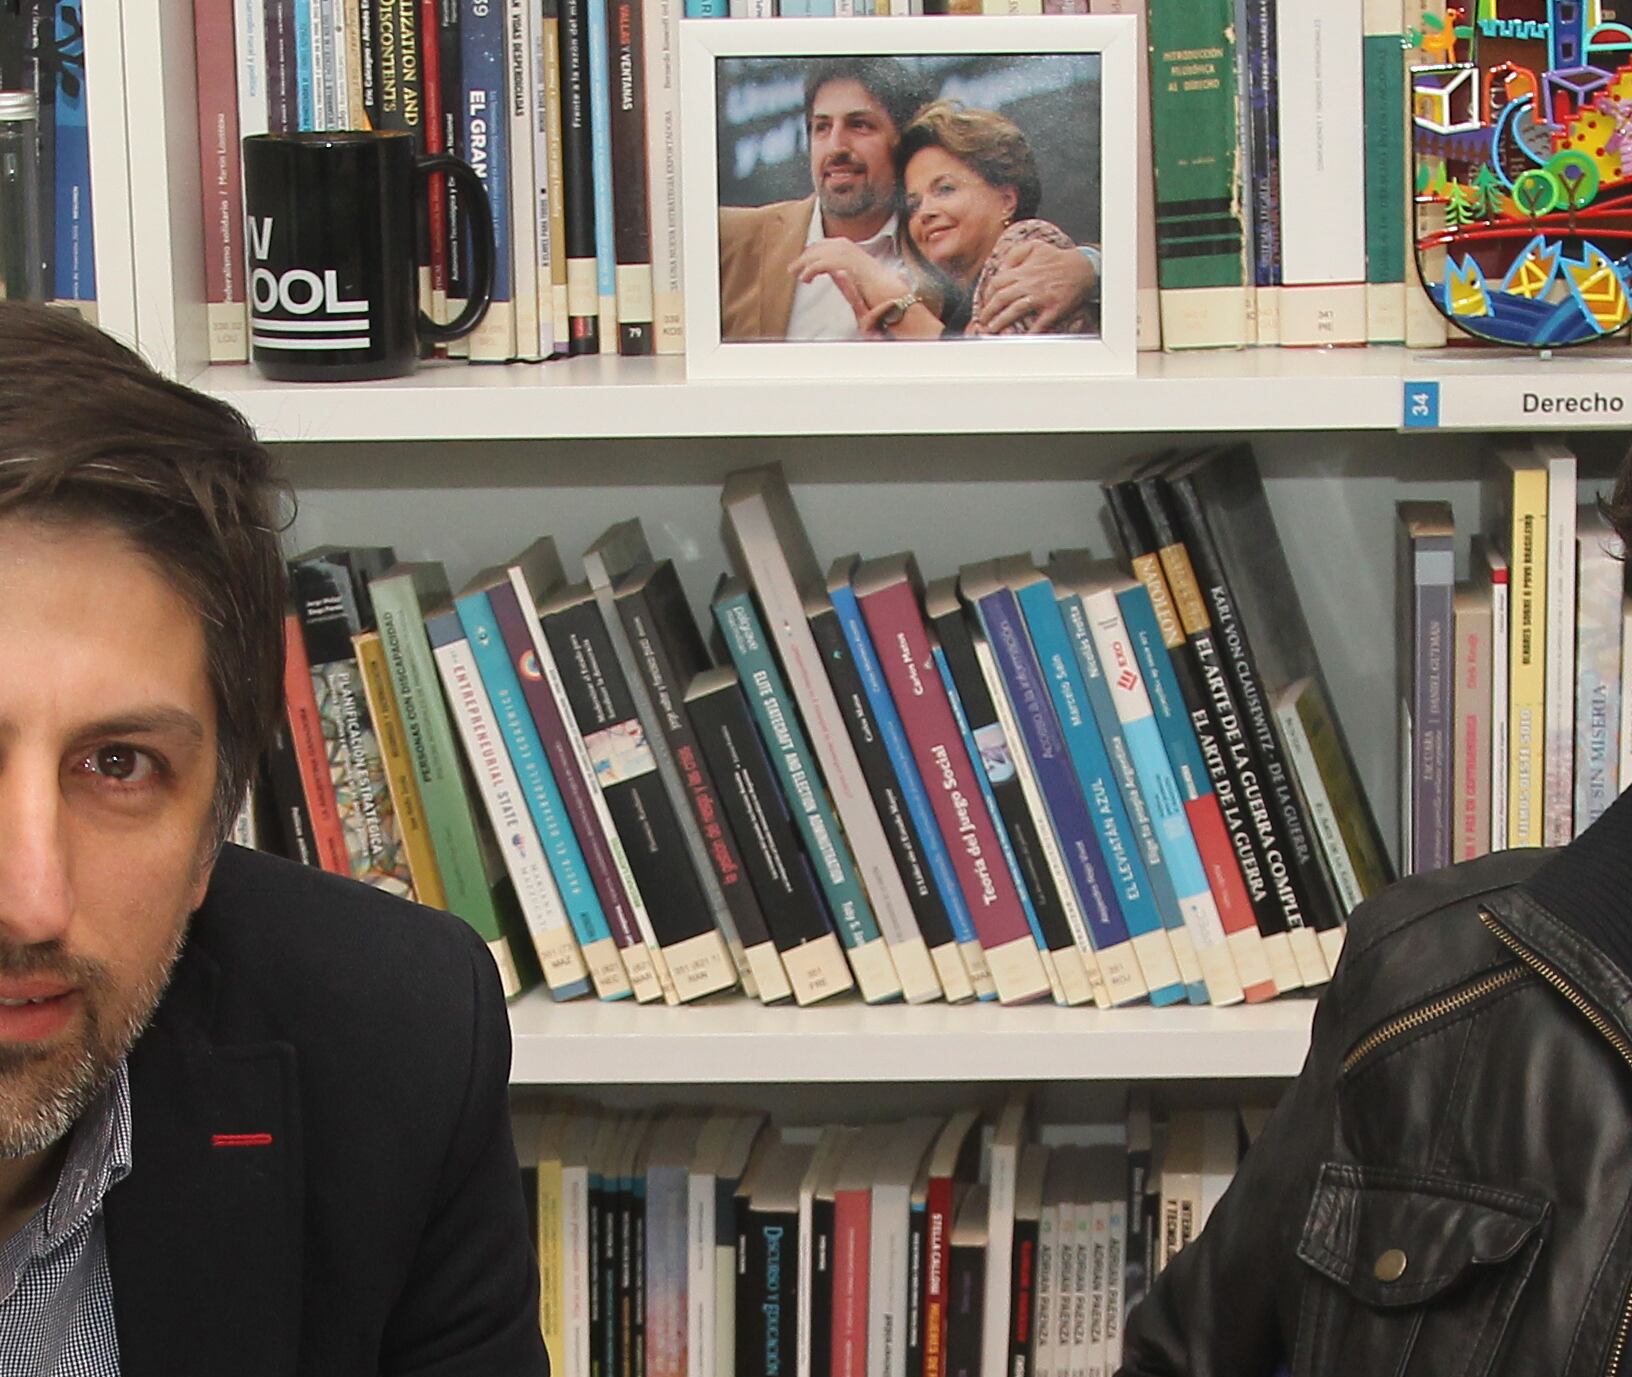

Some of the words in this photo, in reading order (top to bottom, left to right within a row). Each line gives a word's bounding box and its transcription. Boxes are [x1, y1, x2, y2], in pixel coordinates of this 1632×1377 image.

[508, 13, 523, 40] VIDAS
[618, 45, 632, 53] Y
[618, 53, 637, 110] VENTANAS
[401, 86, 423, 127] AND
[465, 89, 485, 111] EL
[571, 92, 581, 128] Frente
[468, 118, 491, 178] GRAN
[627, 326, 642, 339] 79
[1410, 391, 1429, 418] 34
[1522, 392, 1624, 415] Derecho
[1068, 603, 1089, 639] Trotta
[1210, 584, 1234, 623] KARL
[383, 610, 411, 695] DISCAPACIDAD
[895, 631, 915, 663] Matus
[1078, 637, 1101, 679] Nicolás
[1111, 639, 1127, 668] EXO
[1193, 635, 1216, 662] EL
[1222, 623, 1245, 659] VON
[750, 668, 773, 697] ELITE
[904, 662, 925, 696] Carlos
[1201, 661, 1233, 713] ARTE
[402, 695, 418, 721] CON
[1189, 707, 1210, 733] EL
[1233, 658, 1275, 752] CLAUSEWITZ
[1589, 682, 1613, 761] MISERIA
[761, 696, 795, 752] STATECRAFT
[1218, 712, 1243, 743] DE
[408, 721, 431, 783] PERSONAS
[449, 663, 507, 788] ENTREPRENEURIAL
[495, 788, 522, 827] STATE
[782, 749, 803, 772] AND
[1110, 733, 1137, 788] Argentina
[1198, 732, 1226, 779] ARTE
[1228, 742, 1251, 769] LA
[932, 743, 960, 790] Social
[1266, 759, 1285, 783] DE
[1586, 767, 1605, 798] SIN
[790, 769, 819, 814] ELECTION
[1088, 776, 1113, 816] AZUL
[1214, 778, 1235, 806] DE
[1237, 767, 1278, 848] GUERRA
[1273, 783, 1291, 803] LA
[1223, 807, 1244, 830] LA
[1279, 802, 1311, 864] GUERRA
[961, 831, 983, 859] del
[1102, 815, 1136, 881] LEVIATÁN
[970, 858, 998, 907] Teoría
[1231, 829, 1268, 902] GUERRA
[1124, 880, 1142, 900] EL
[930, 1212, 942, 1250] STELLA
